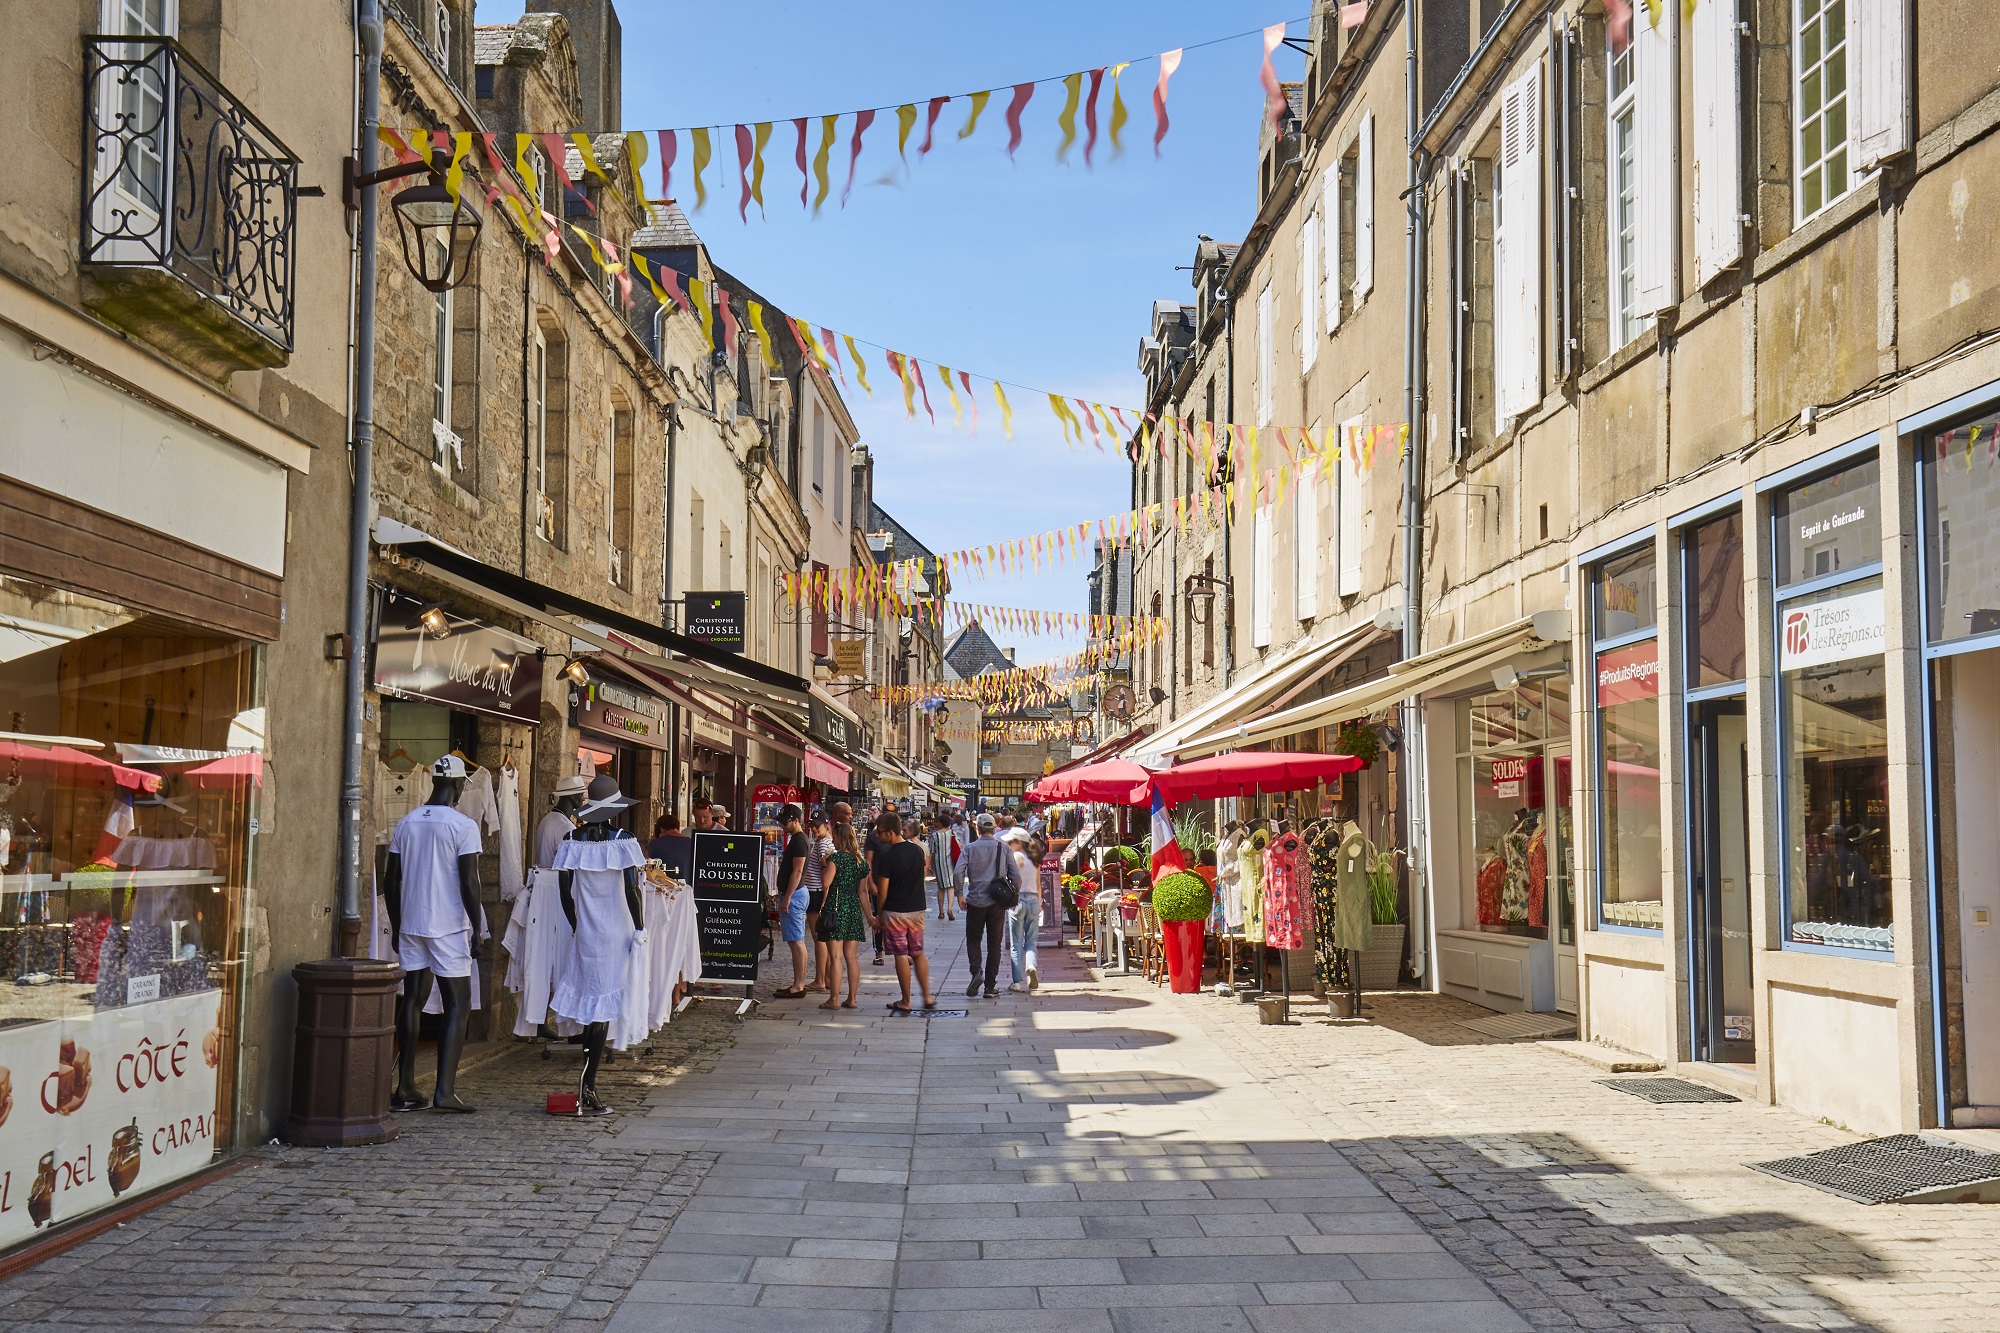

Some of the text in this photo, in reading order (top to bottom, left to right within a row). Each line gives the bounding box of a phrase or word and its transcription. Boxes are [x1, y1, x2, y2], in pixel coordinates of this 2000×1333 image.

[1801, 507, 1866, 540] Esprit de Guérande
[1813, 608, 1850, 628] Trésors
[689, 624, 741, 634] ROUSSEL
[449, 634, 520, 698] blanc du Nil
[635, 696, 657, 719] ROUSSEL
[1493, 759, 1524, 780] SOLDES
[699, 868, 754, 881] ROUSSEL
[706, 916, 741, 925] GUÉRANDE
[704, 927, 742, 935] PORNICHET
[713, 938, 732, 946] PARIS
[132, 978, 155, 989] CARAMEL
[116, 1028, 189, 1093] CÔTÉ
